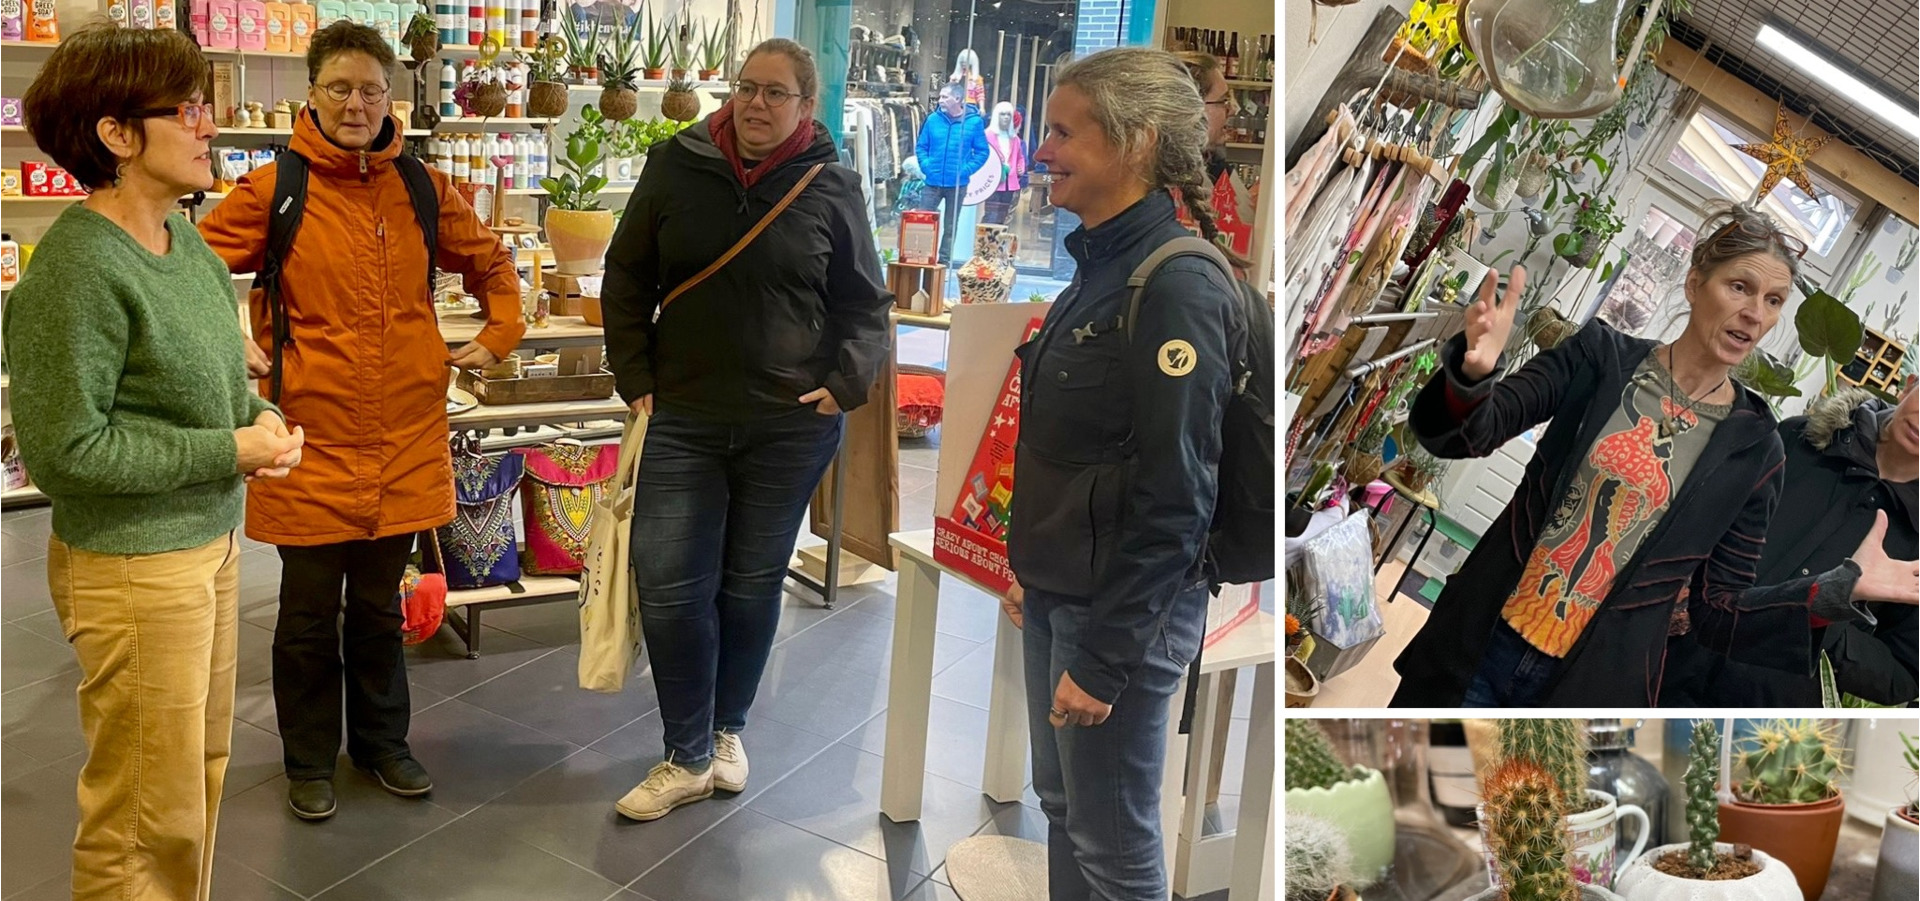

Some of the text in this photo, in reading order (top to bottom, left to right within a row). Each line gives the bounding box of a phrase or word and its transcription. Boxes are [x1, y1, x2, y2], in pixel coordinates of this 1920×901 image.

[974, 175, 995, 195] PRICES
[936, 527, 961, 544] CRAZY
[961, 539, 988, 557] ABOUT
[935, 536, 1016, 583] SERIOUS ABOUT PE
